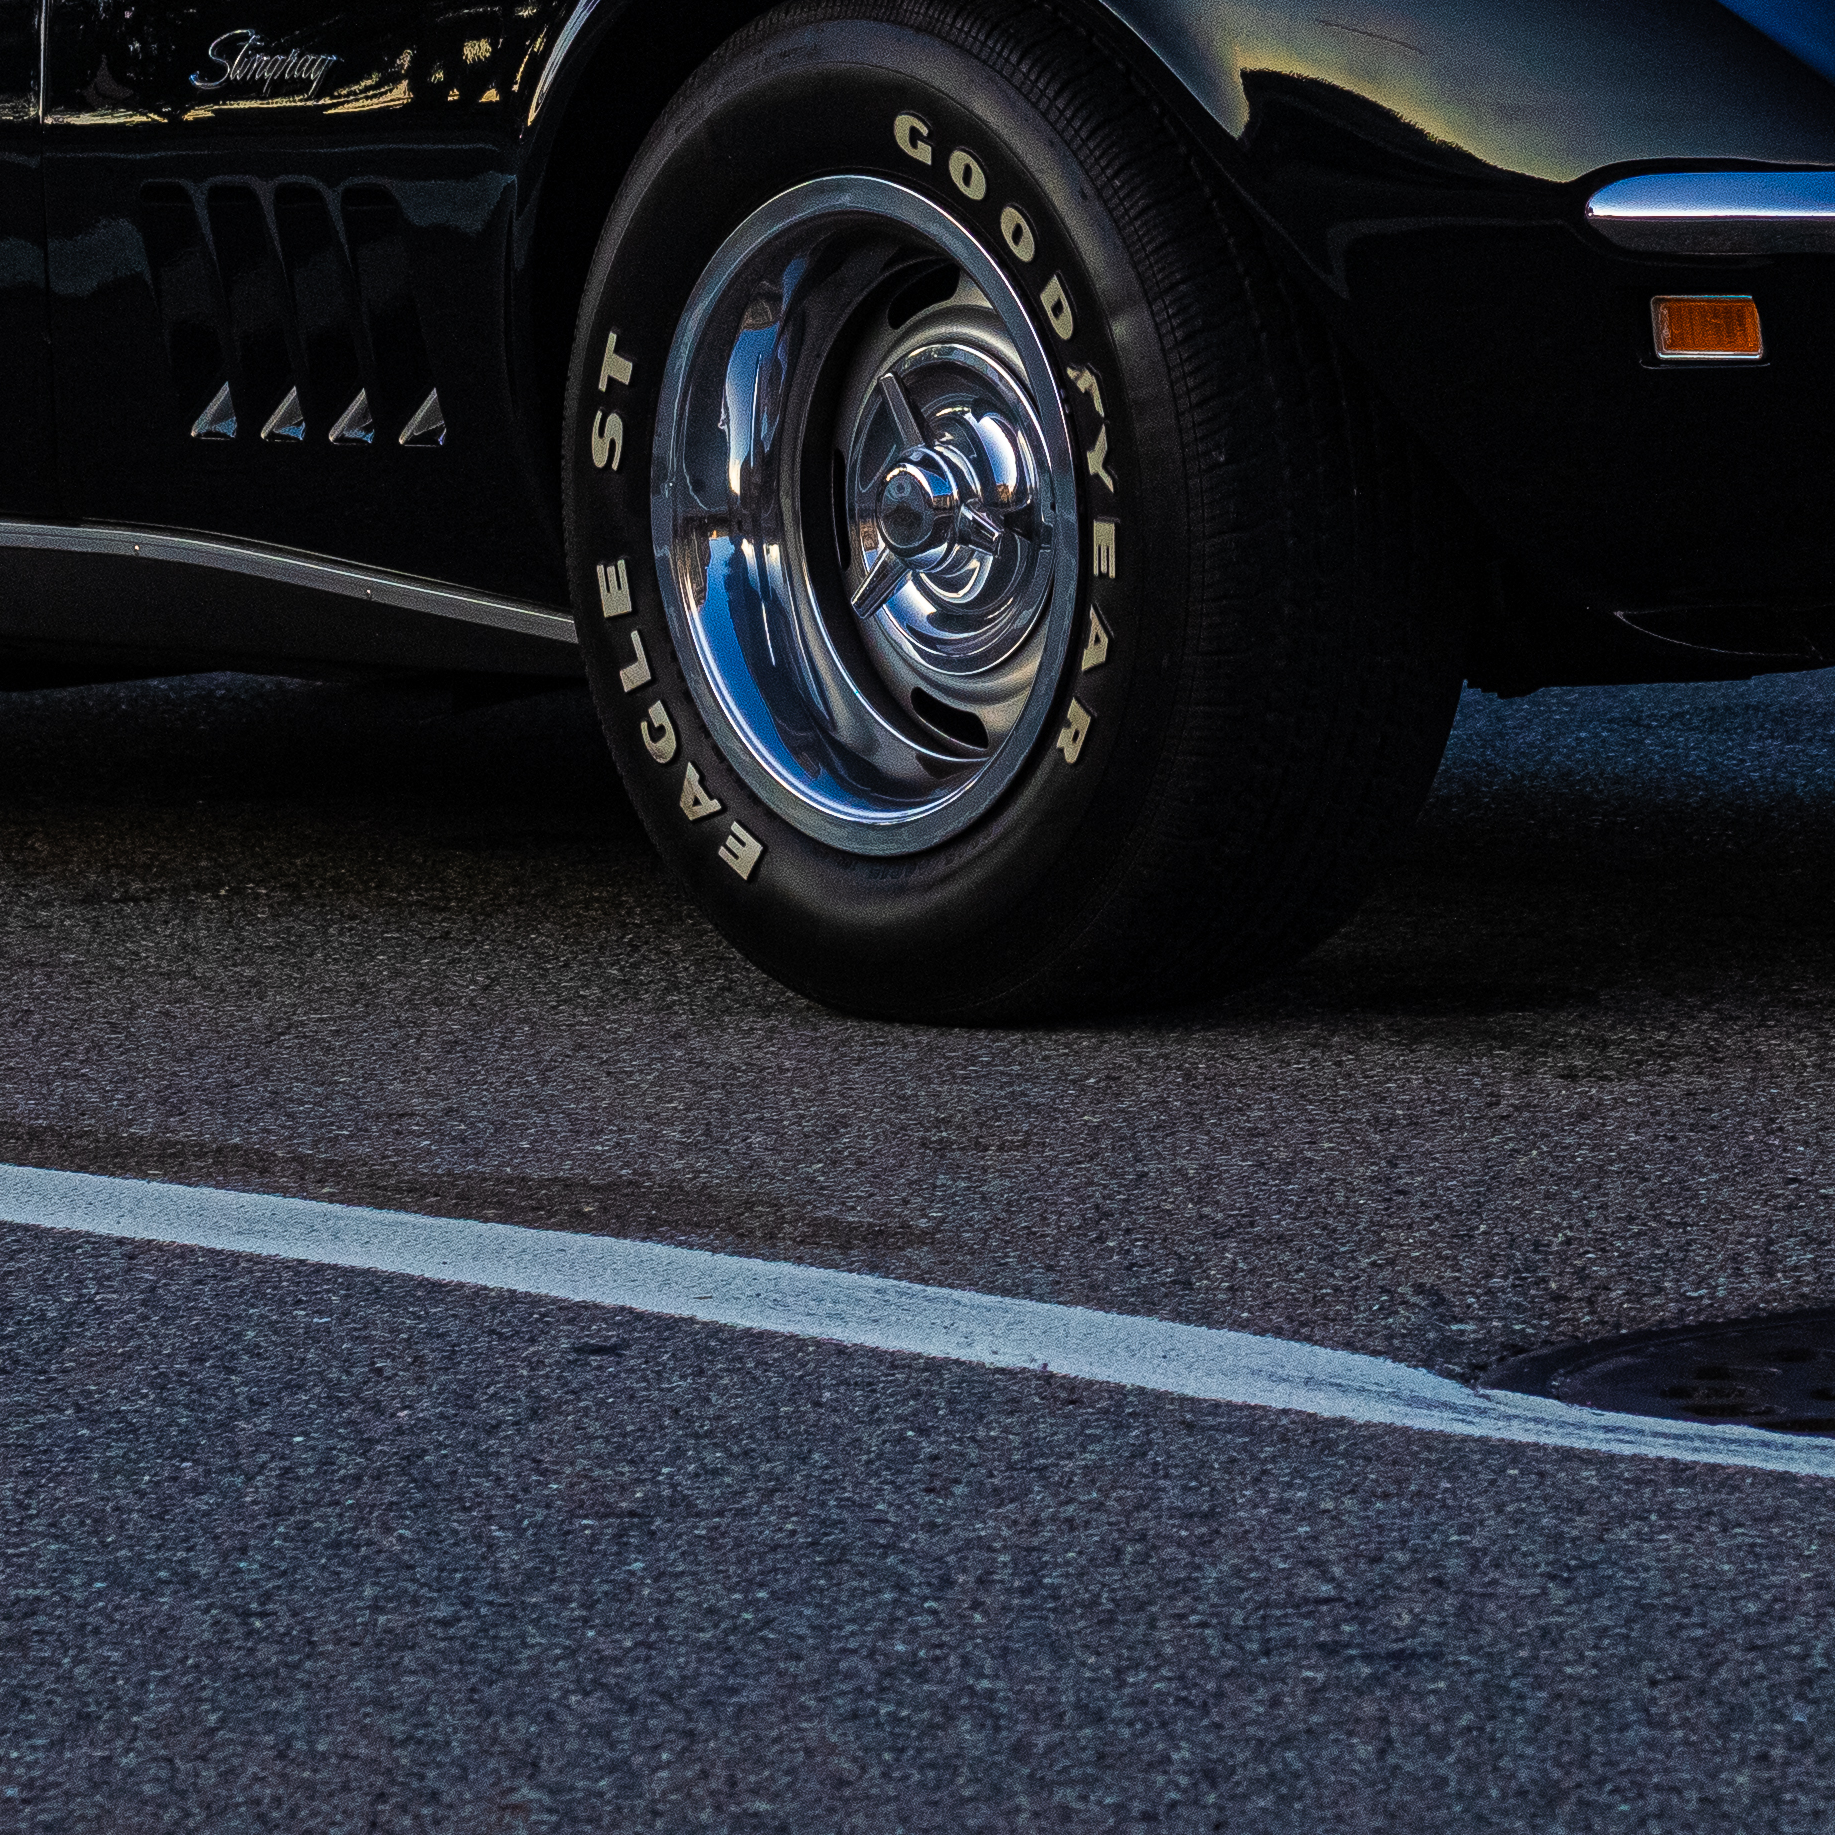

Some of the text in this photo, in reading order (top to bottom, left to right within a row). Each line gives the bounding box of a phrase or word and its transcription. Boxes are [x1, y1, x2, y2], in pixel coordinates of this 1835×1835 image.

[189, 28, 344, 98] Stingray
[592, 330, 764, 882] EAGLE ST
[893, 110, 1119, 766] GOODYEAR
